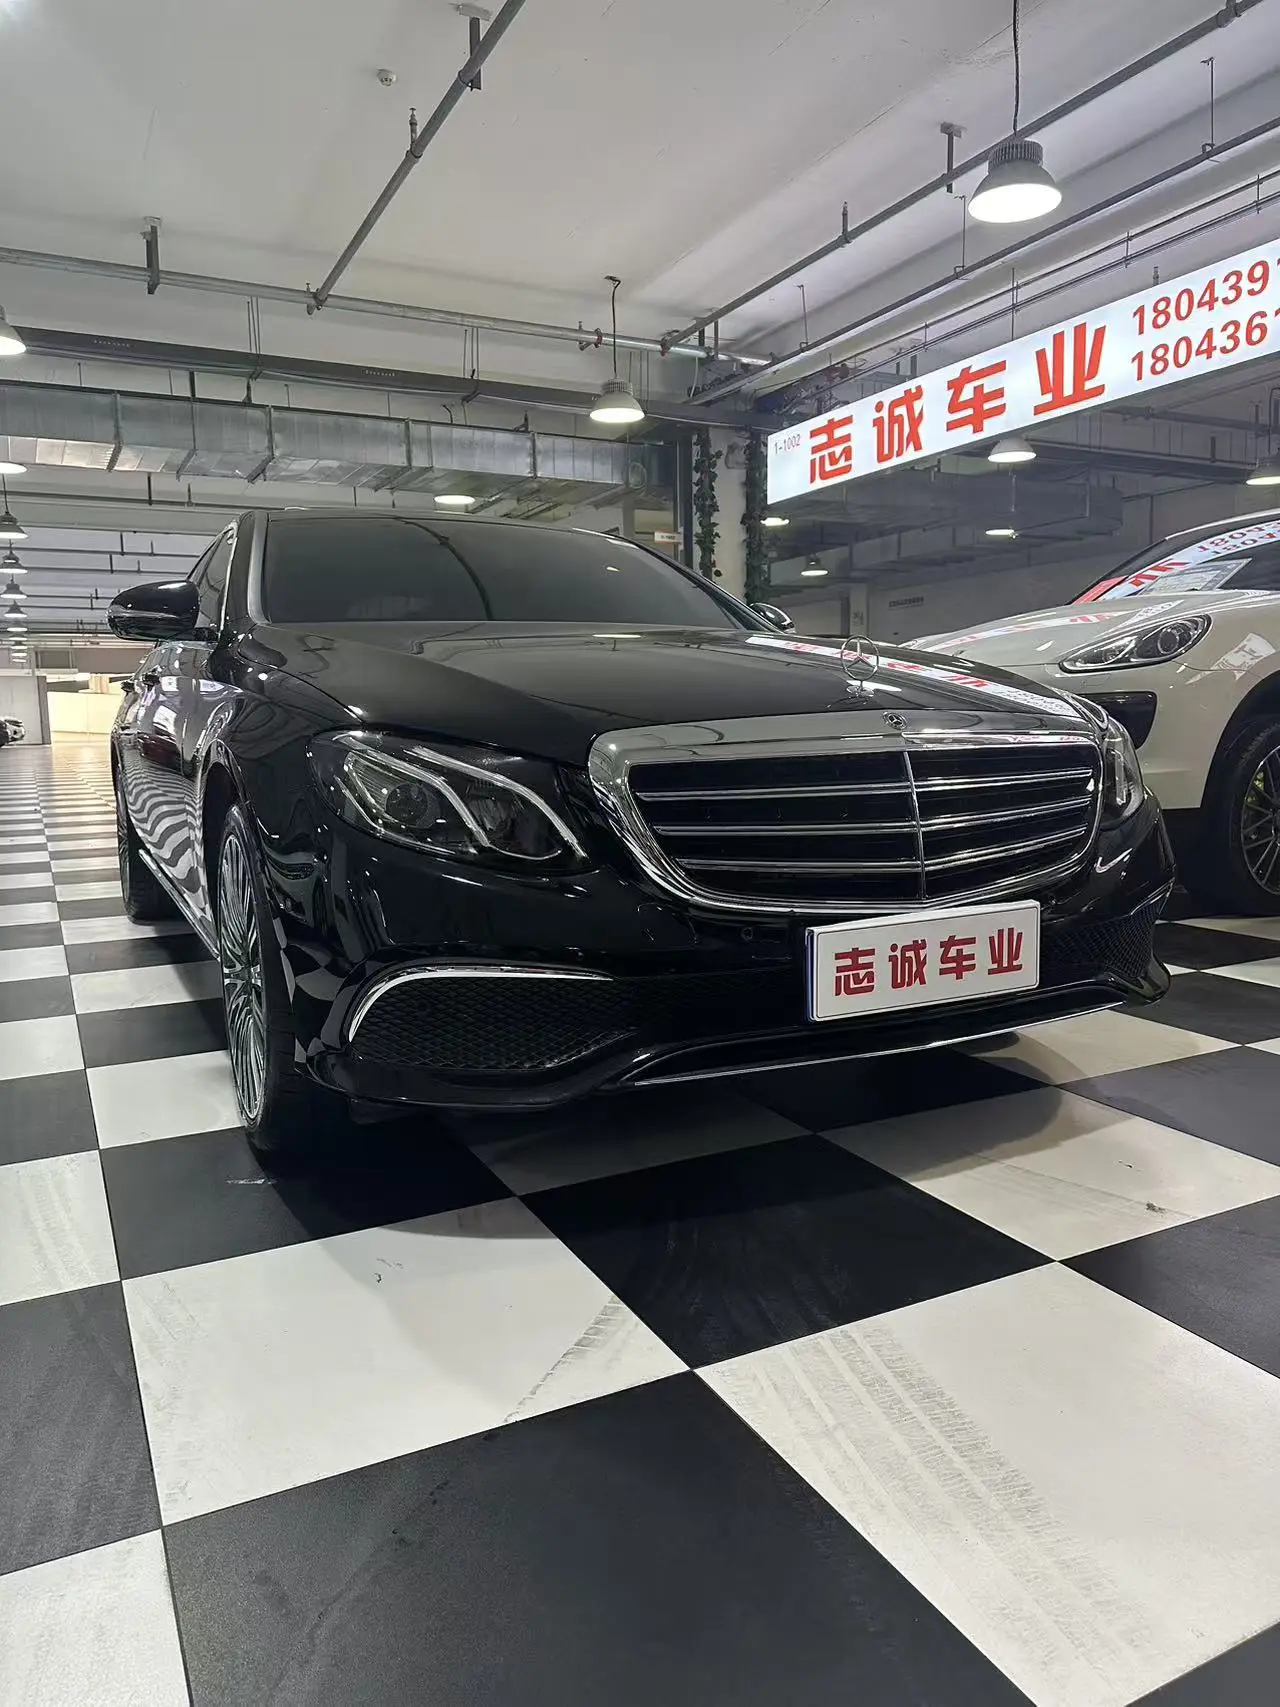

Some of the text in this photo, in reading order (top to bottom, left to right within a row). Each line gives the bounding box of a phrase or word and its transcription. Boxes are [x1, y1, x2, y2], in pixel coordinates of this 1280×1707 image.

[1132, 258, 1280, 336] 180439
[1130, 308, 1280, 381] 180436
[809, 321, 1106, 484] 志诚车业
[774, 433, 801, 454] 1-1002
[834, 927, 1023, 997] 志诚车业
